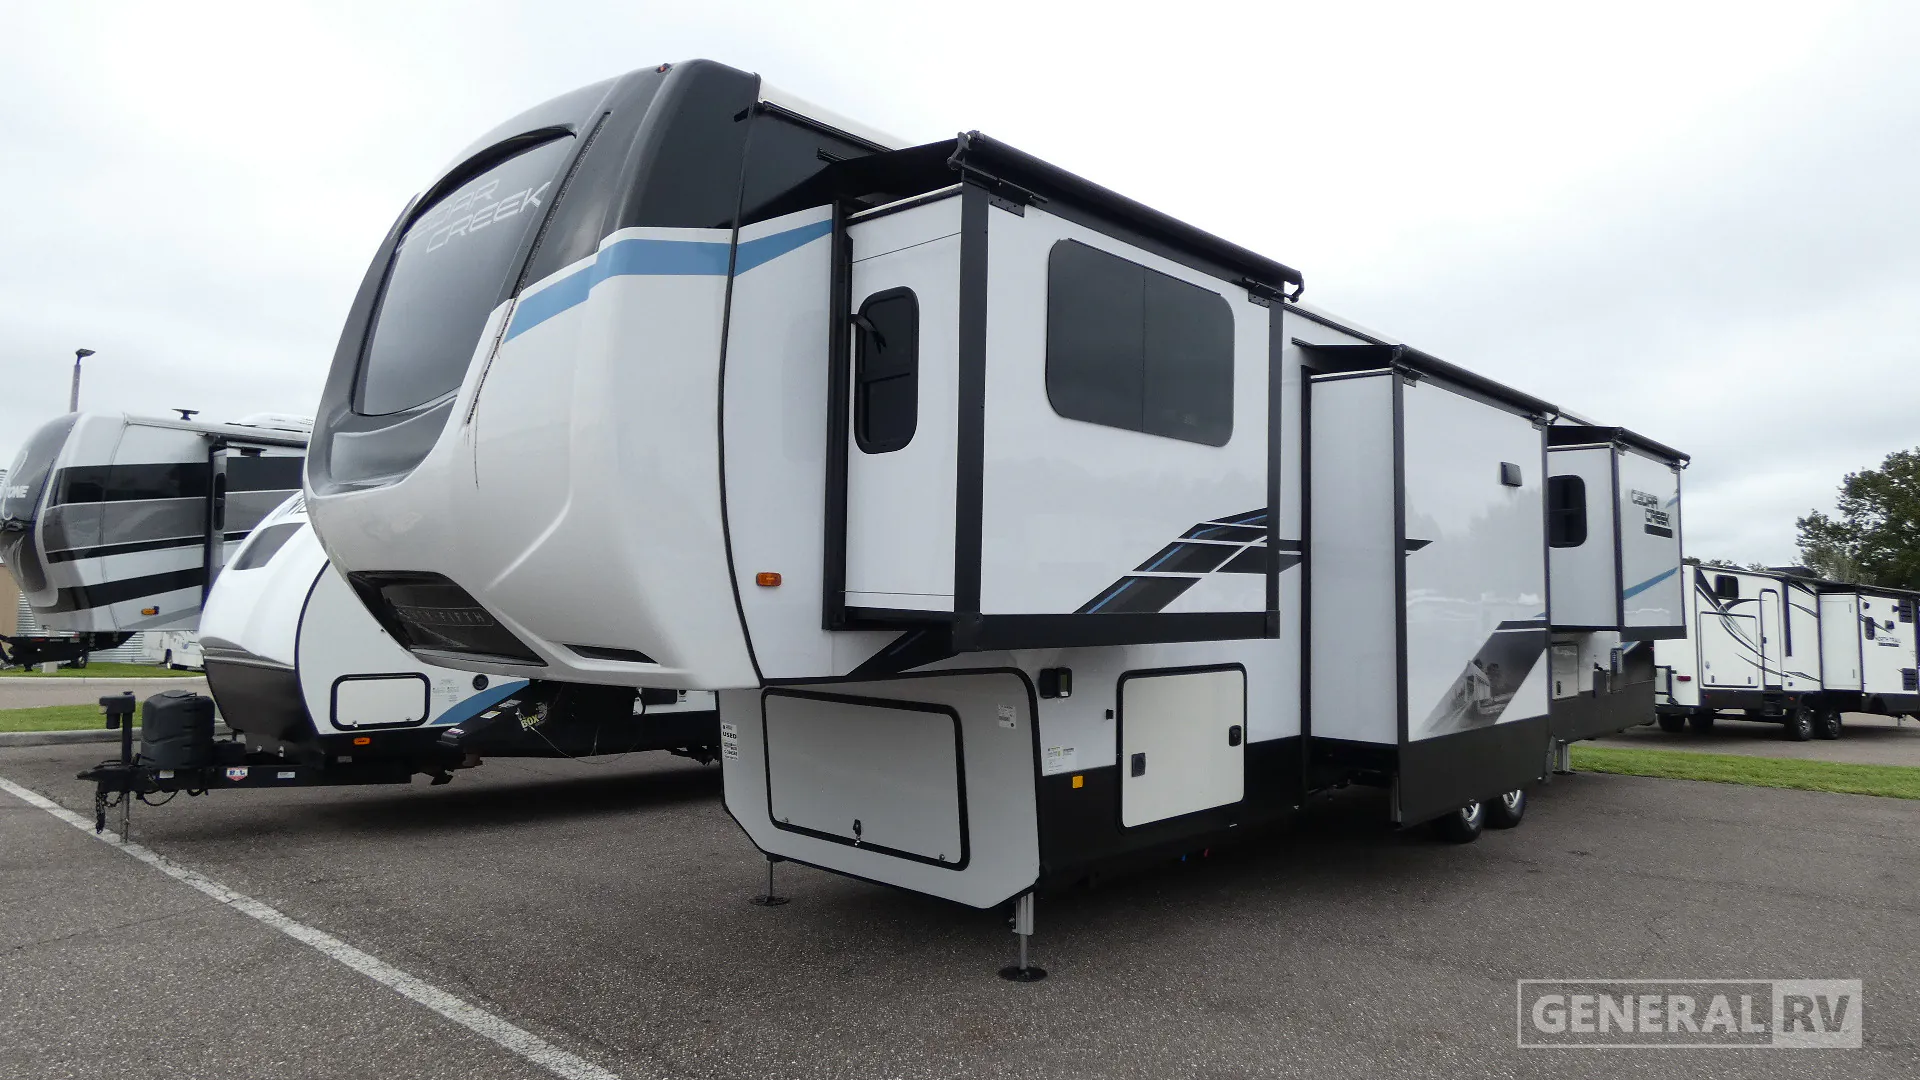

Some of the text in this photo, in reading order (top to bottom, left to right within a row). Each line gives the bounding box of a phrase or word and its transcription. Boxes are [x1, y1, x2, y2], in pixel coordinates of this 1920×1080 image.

[426, 181, 551, 253] CREEK
[1631, 489, 1658, 510] CEDAR
[1645, 508, 1670, 527] CREEK
[722, 731, 737, 739] USED
